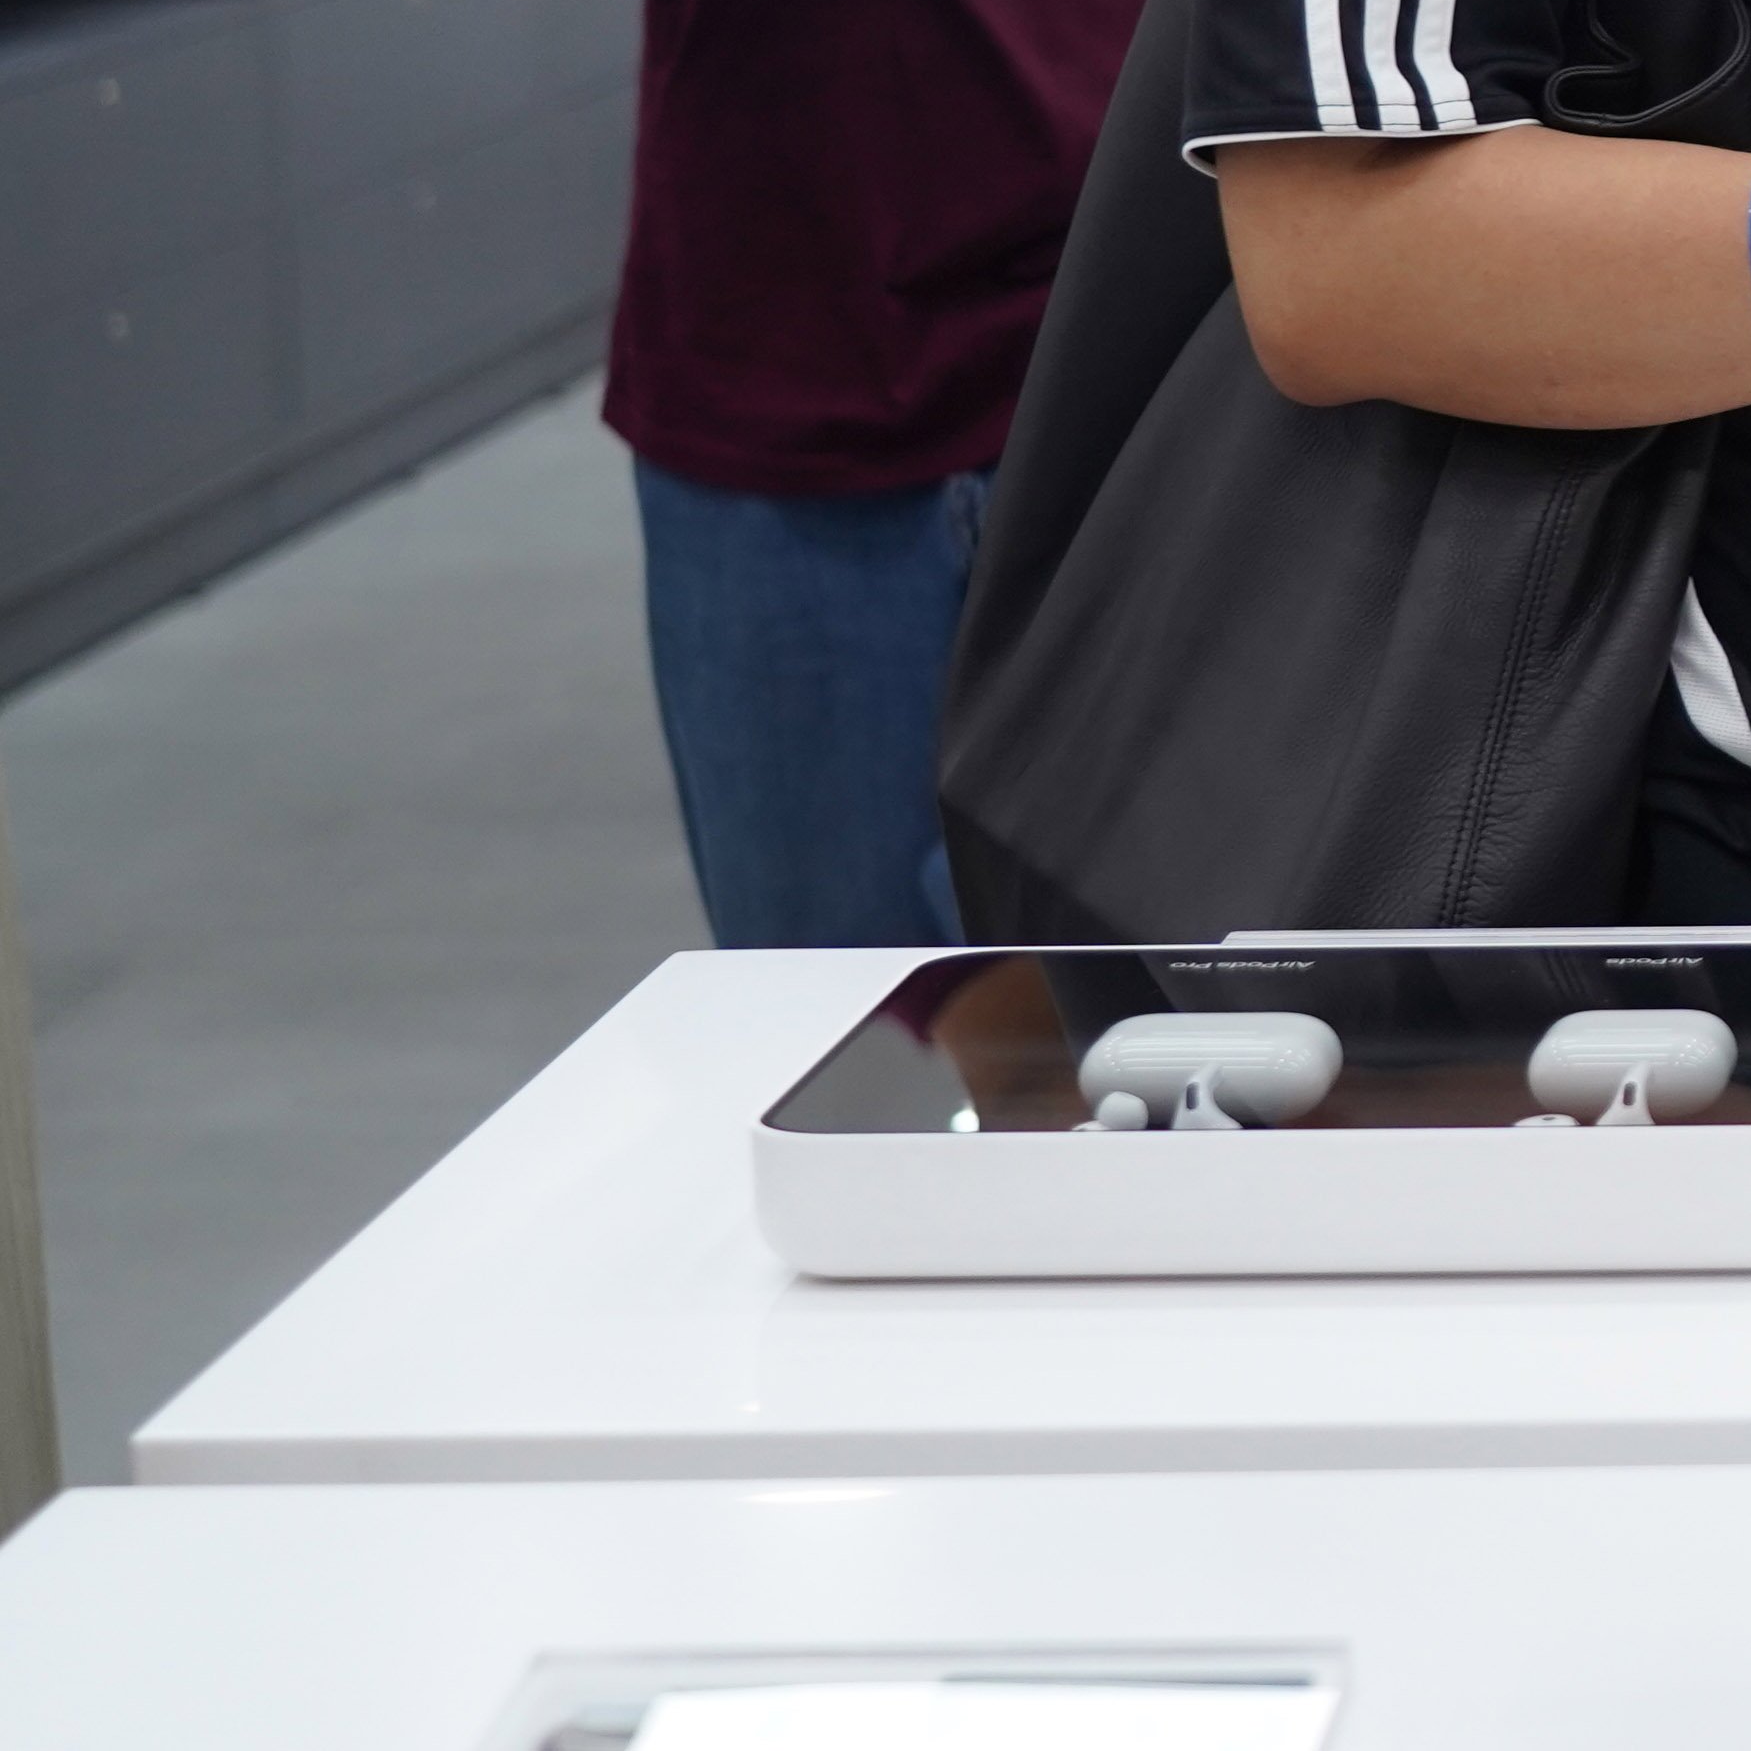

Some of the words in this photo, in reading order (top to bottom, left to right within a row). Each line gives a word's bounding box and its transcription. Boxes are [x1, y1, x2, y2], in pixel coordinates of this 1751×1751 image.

[1169, 961, 1213, 973] Pro
[1215, 960, 1317, 973] AirPods
[1605, 957, 1705, 969] AirPods
